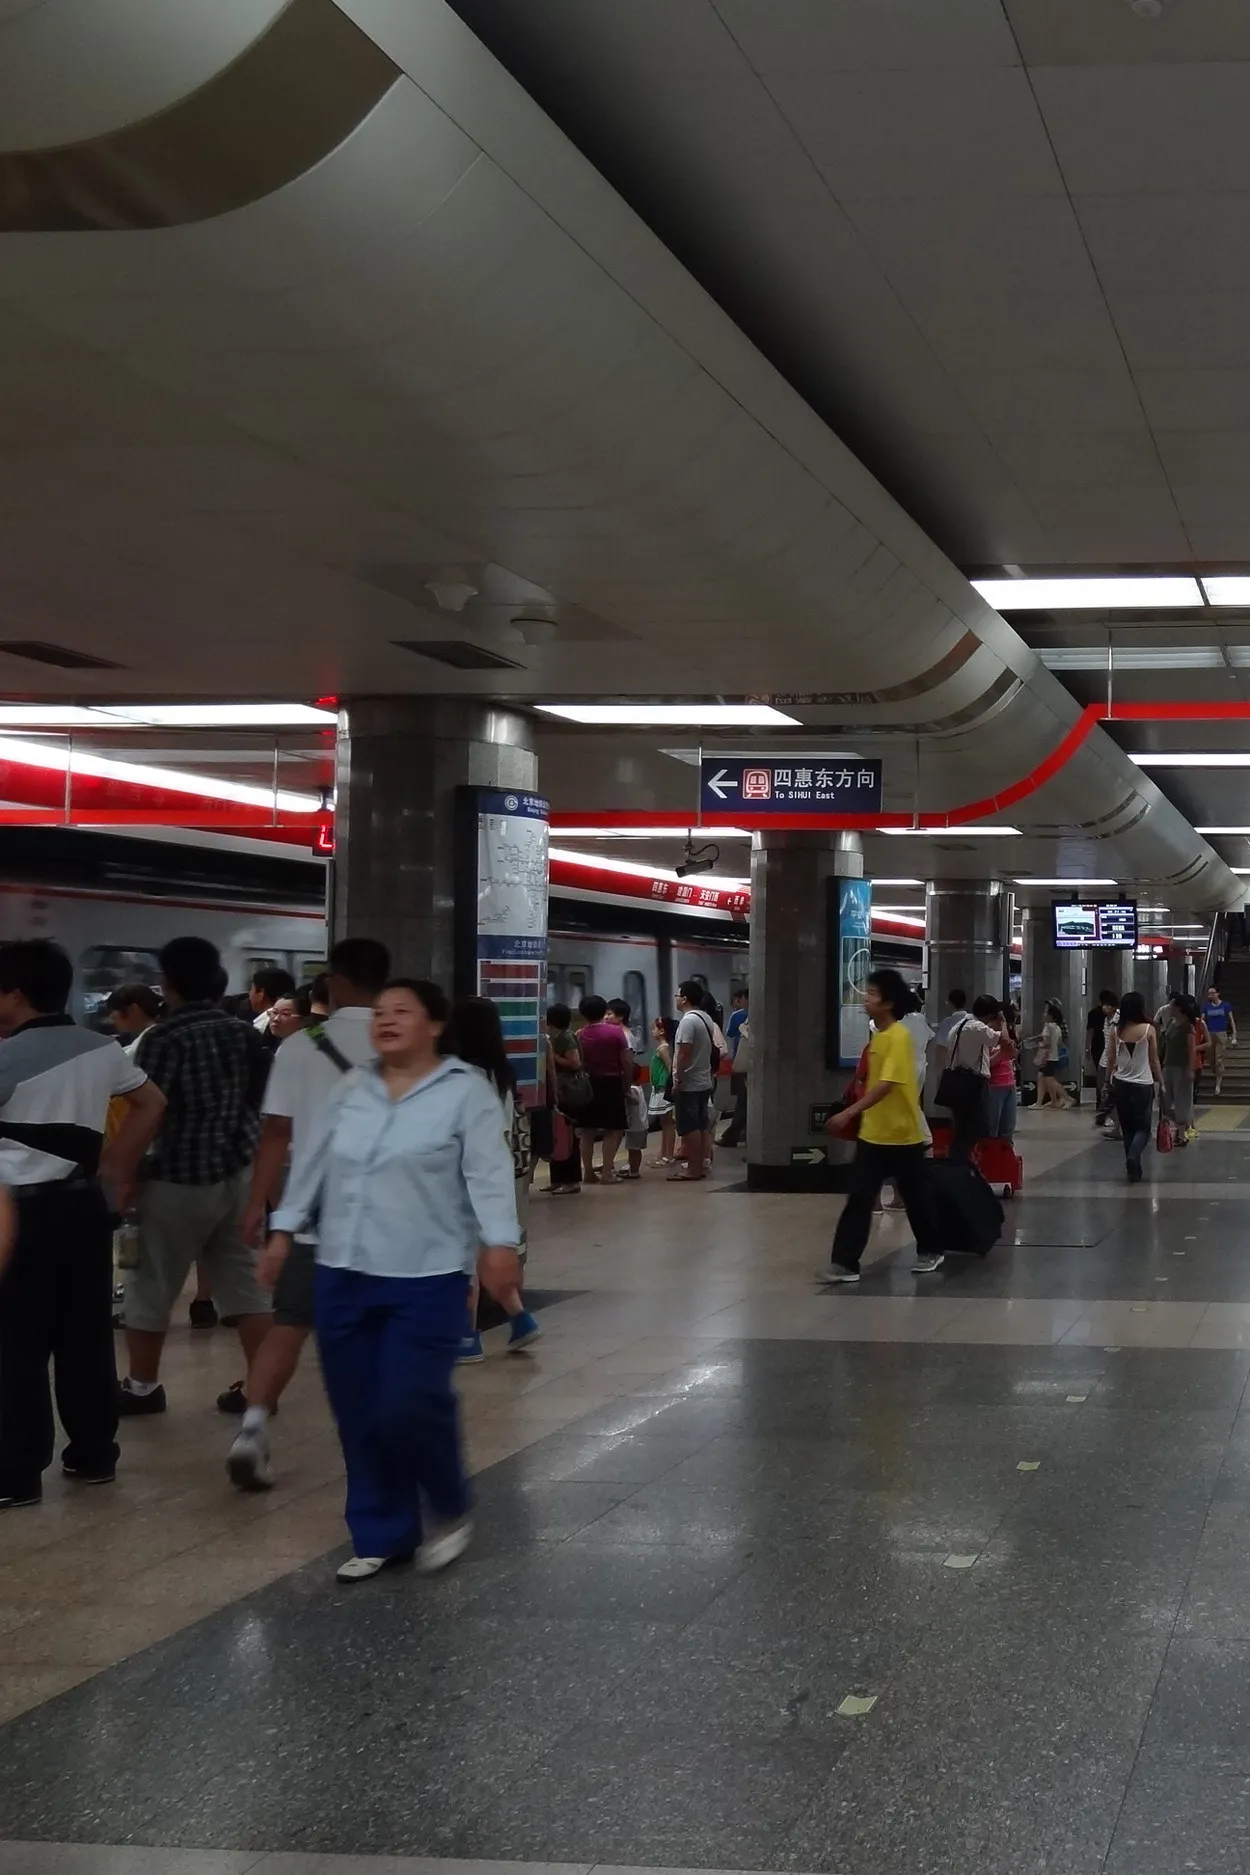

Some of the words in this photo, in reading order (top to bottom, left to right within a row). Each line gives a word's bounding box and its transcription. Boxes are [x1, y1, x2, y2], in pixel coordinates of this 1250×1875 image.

[774, 768, 874, 788] 四惠东方向
[775, 791, 785, 799] To
[788, 791, 811, 799] SIHUI
[816, 791, 835, 799] East
[699, 889, 720, 902] 天安门西
